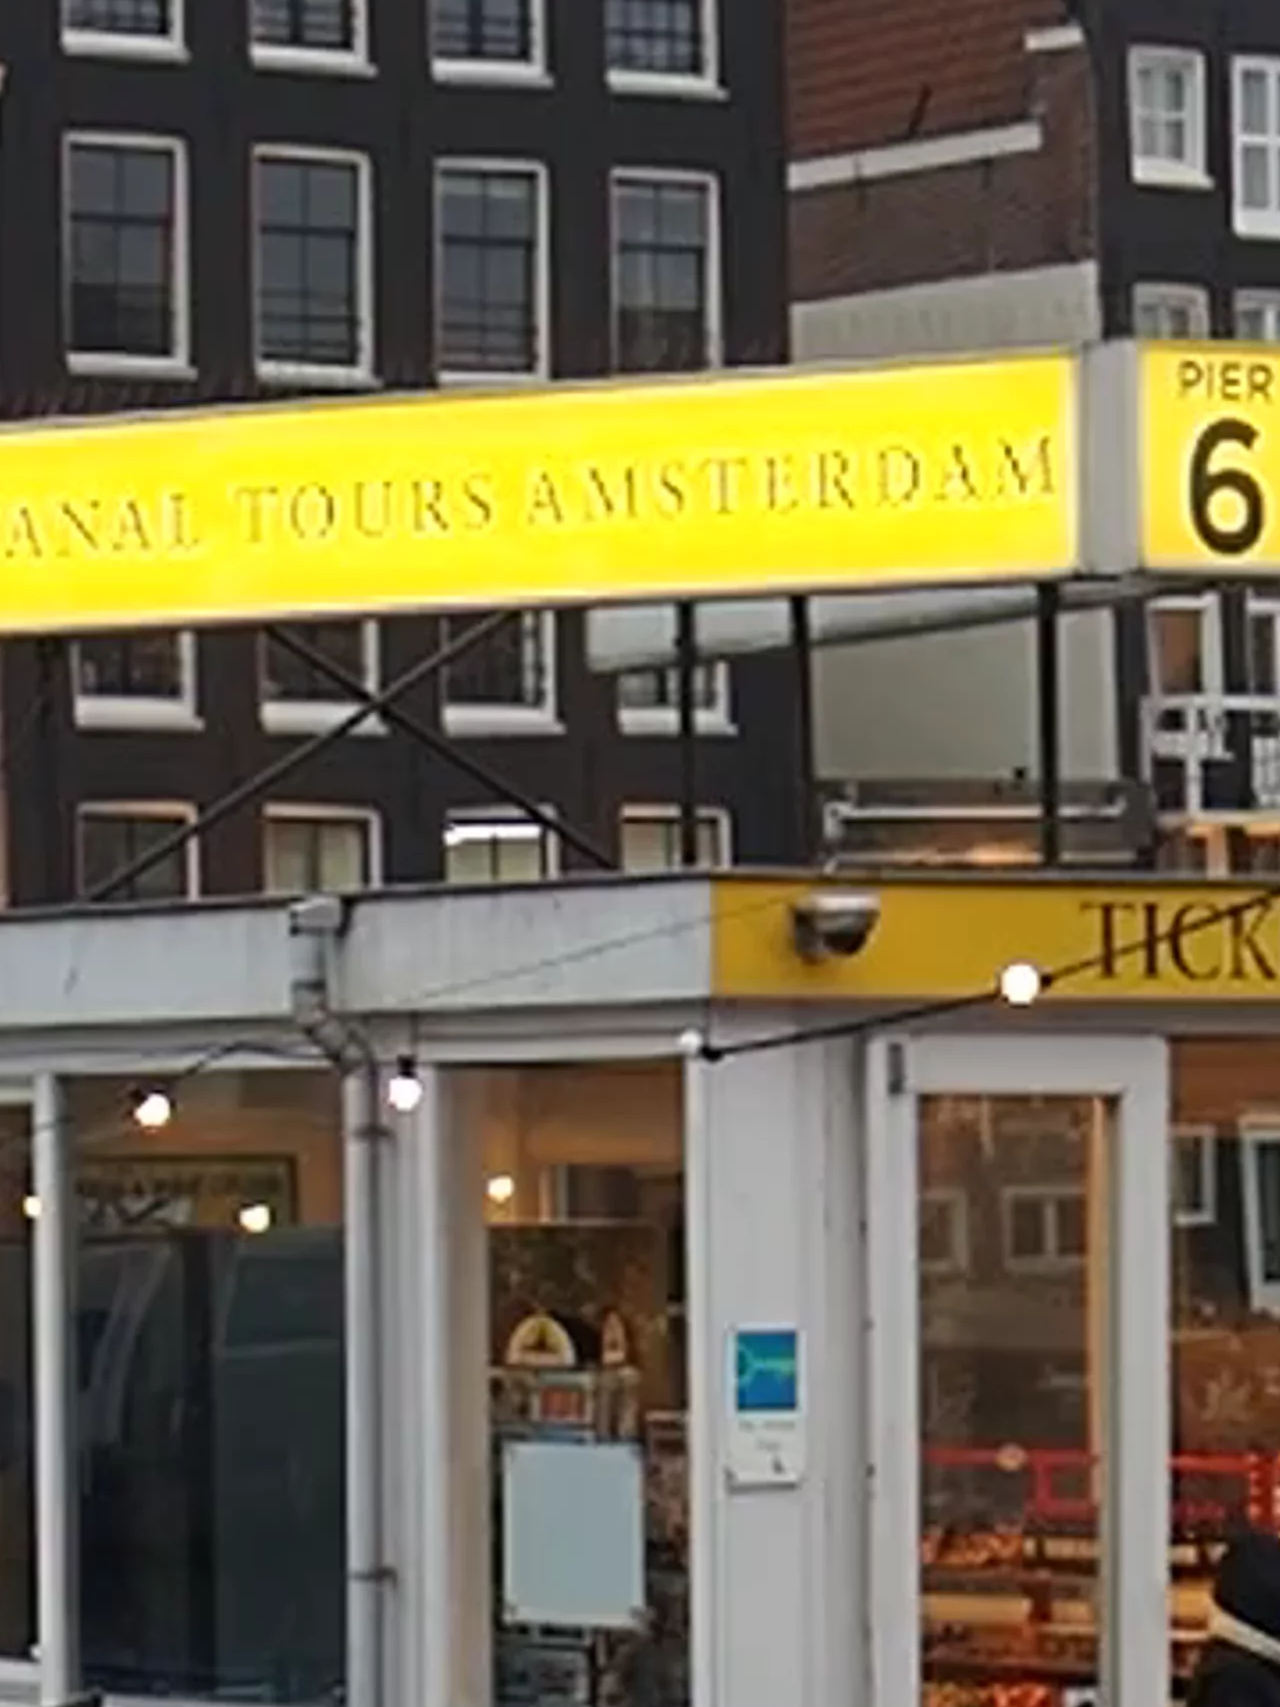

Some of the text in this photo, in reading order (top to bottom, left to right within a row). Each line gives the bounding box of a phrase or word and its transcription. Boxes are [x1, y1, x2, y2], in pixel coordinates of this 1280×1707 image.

[1177, 360, 1274, 404] PIER
[234, 473, 494, 544] TOURS
[526, 435, 1057, 525] AMSTERDAM
[1189, 416, 1265, 557] 6
